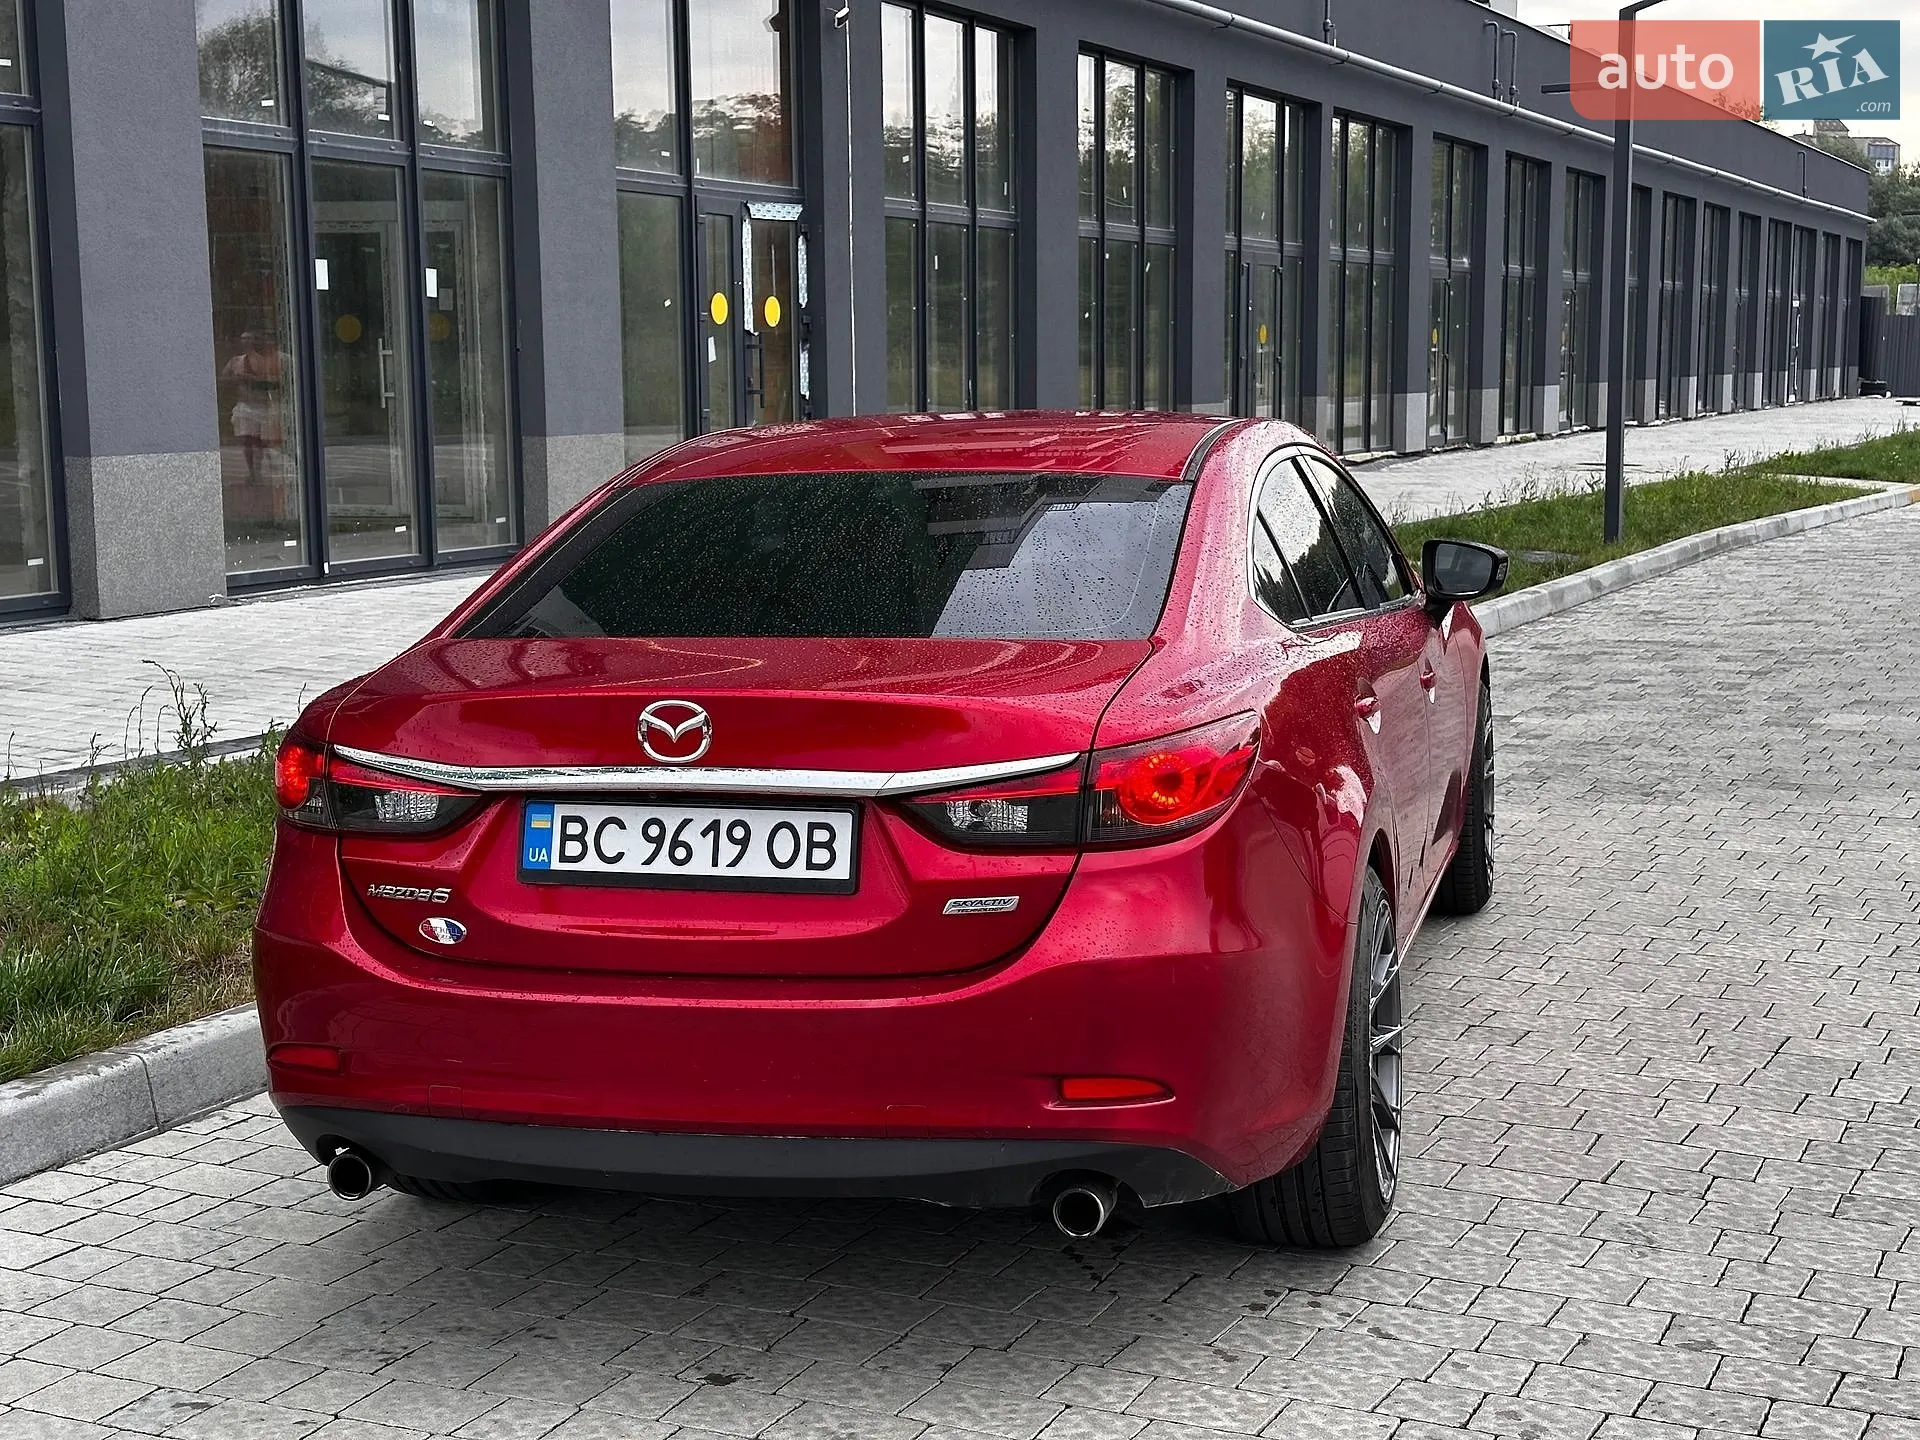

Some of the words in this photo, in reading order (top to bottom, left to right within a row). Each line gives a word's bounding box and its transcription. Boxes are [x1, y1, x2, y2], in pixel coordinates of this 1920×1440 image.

[558, 814, 627, 865] BC
[641, 817, 752, 868] 9619
[766, 820, 837, 871] OB
[528, 847, 548, 863] UA
[951, 899, 1016, 907] SKYACTIV
